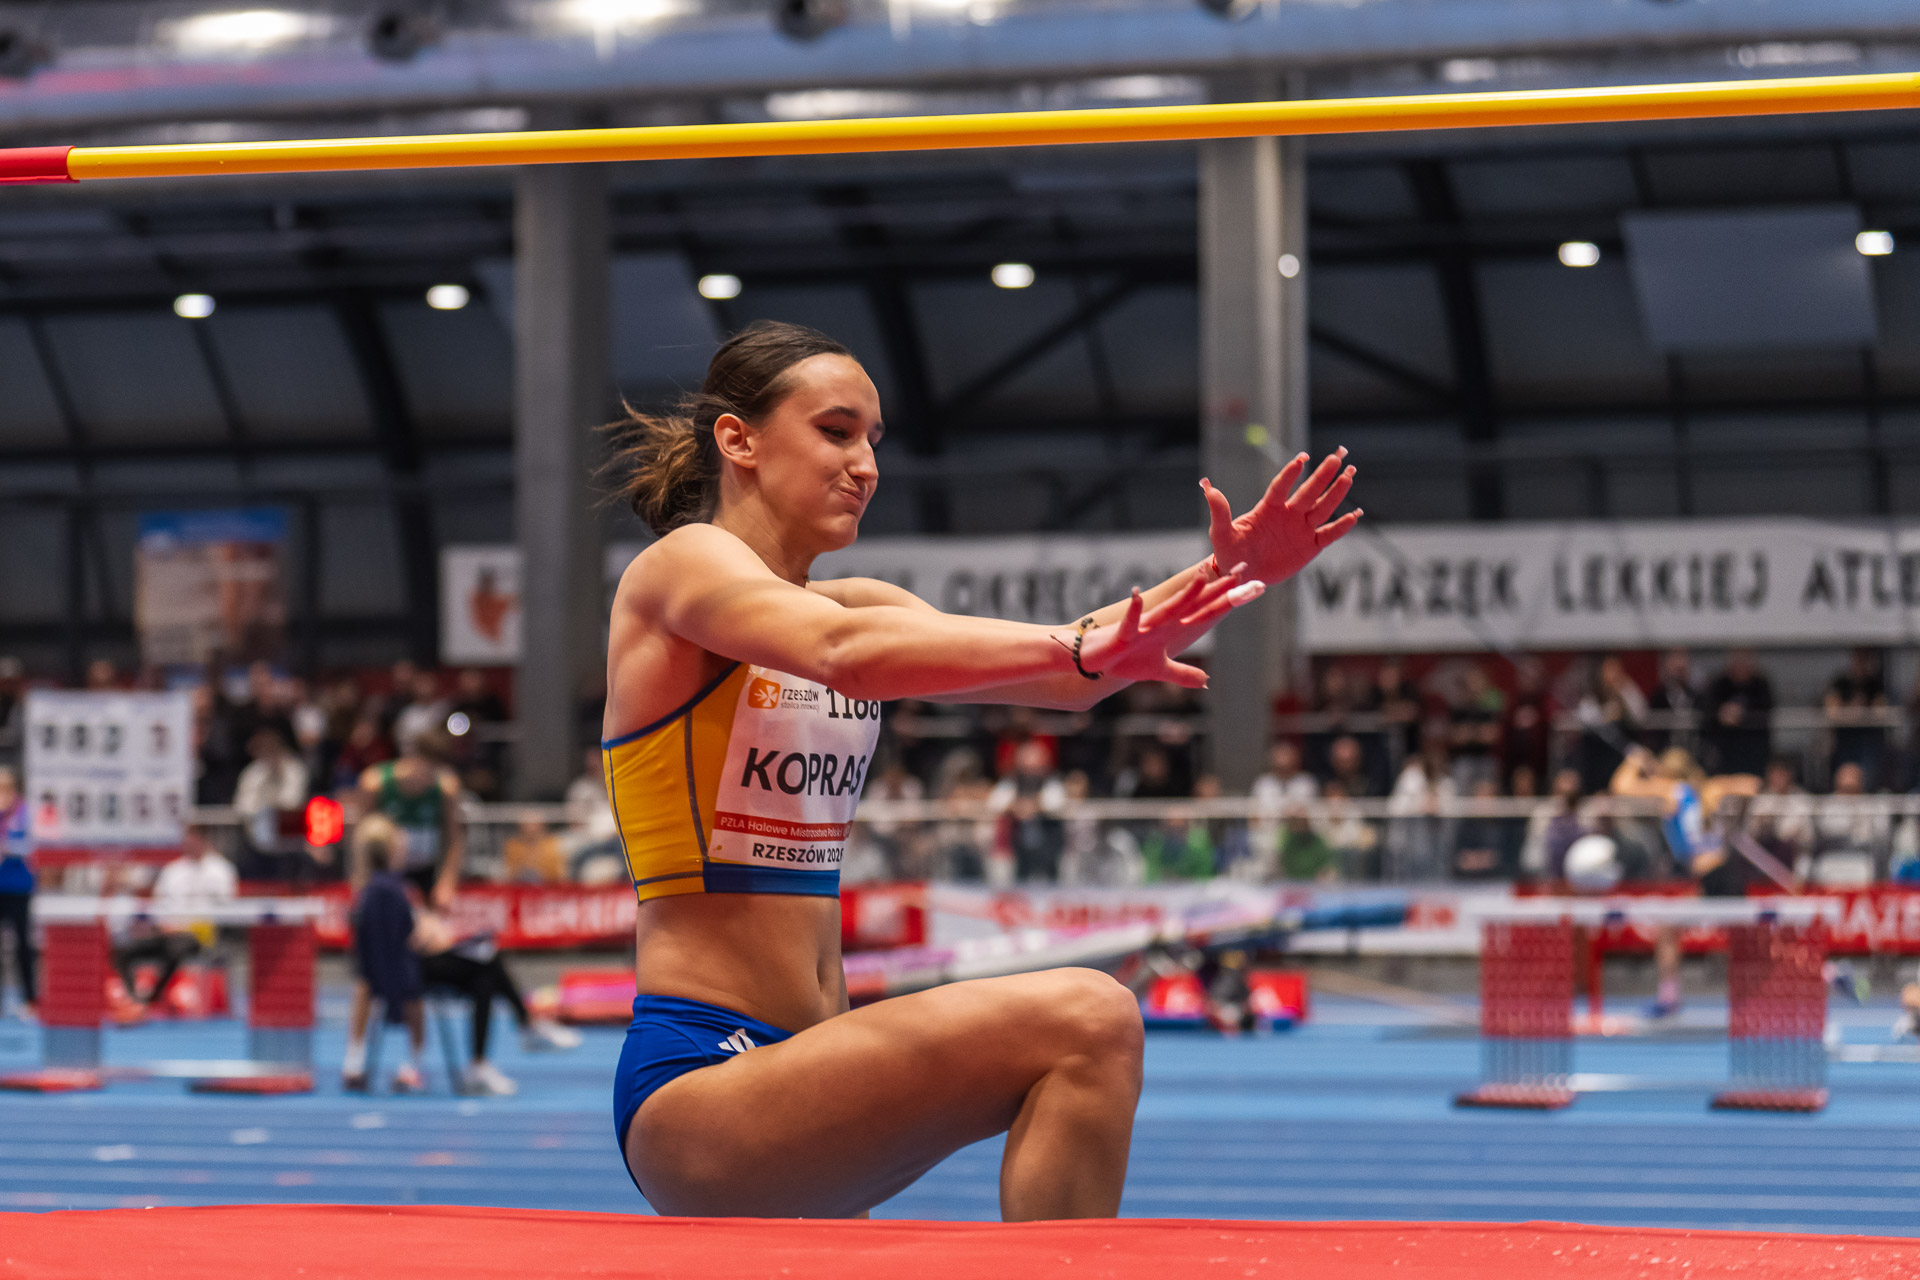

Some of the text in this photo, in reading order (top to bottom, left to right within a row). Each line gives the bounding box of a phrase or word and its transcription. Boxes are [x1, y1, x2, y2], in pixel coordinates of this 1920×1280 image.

[1308, 557, 1520, 618] WIĄZEK
[1553, 553, 1769, 613] LEKKIEJ
[781, 688, 819, 702] rzeszów
[741, 747, 867, 796] KOPRAS
[720, 816, 745, 829] PZLA
[747, 820, 788, 835] Halowe
[752, 843, 825, 863] RZESZÓW
